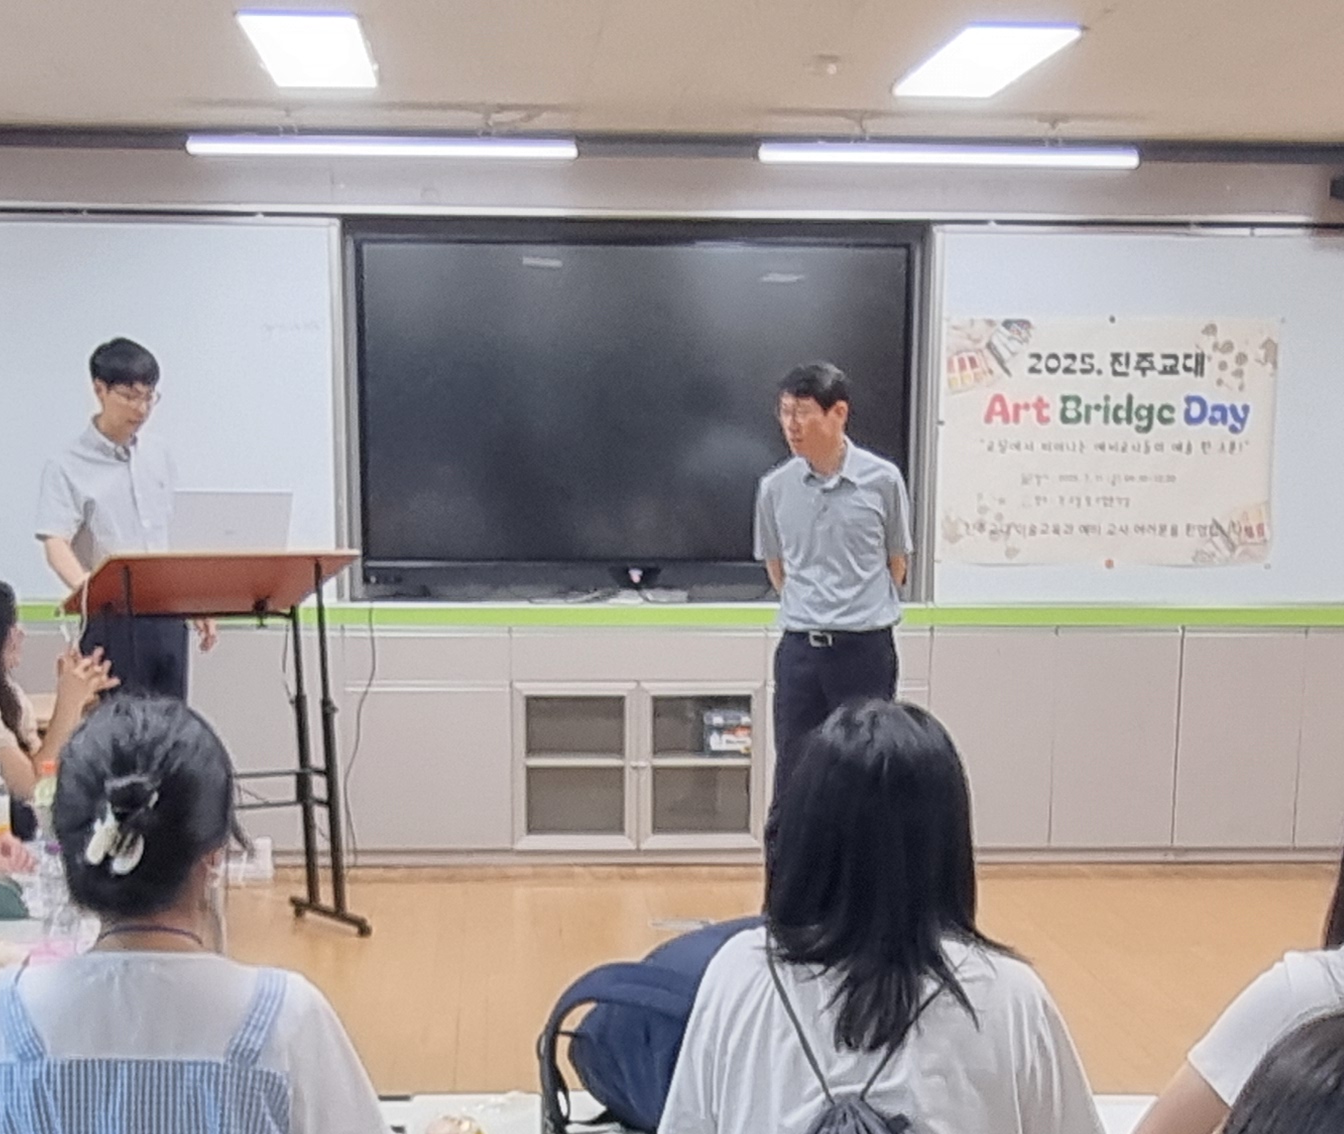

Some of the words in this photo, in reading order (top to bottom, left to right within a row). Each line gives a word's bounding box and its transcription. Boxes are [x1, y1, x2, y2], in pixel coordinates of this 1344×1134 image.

[1028, 352, 1103, 375] 2025.
[1110, 351, 1205, 378] 진주교대
[984, 393, 1051, 425] Art
[1060, 393, 1175, 434] Bridge
[1183, 394, 1250, 435] Day
